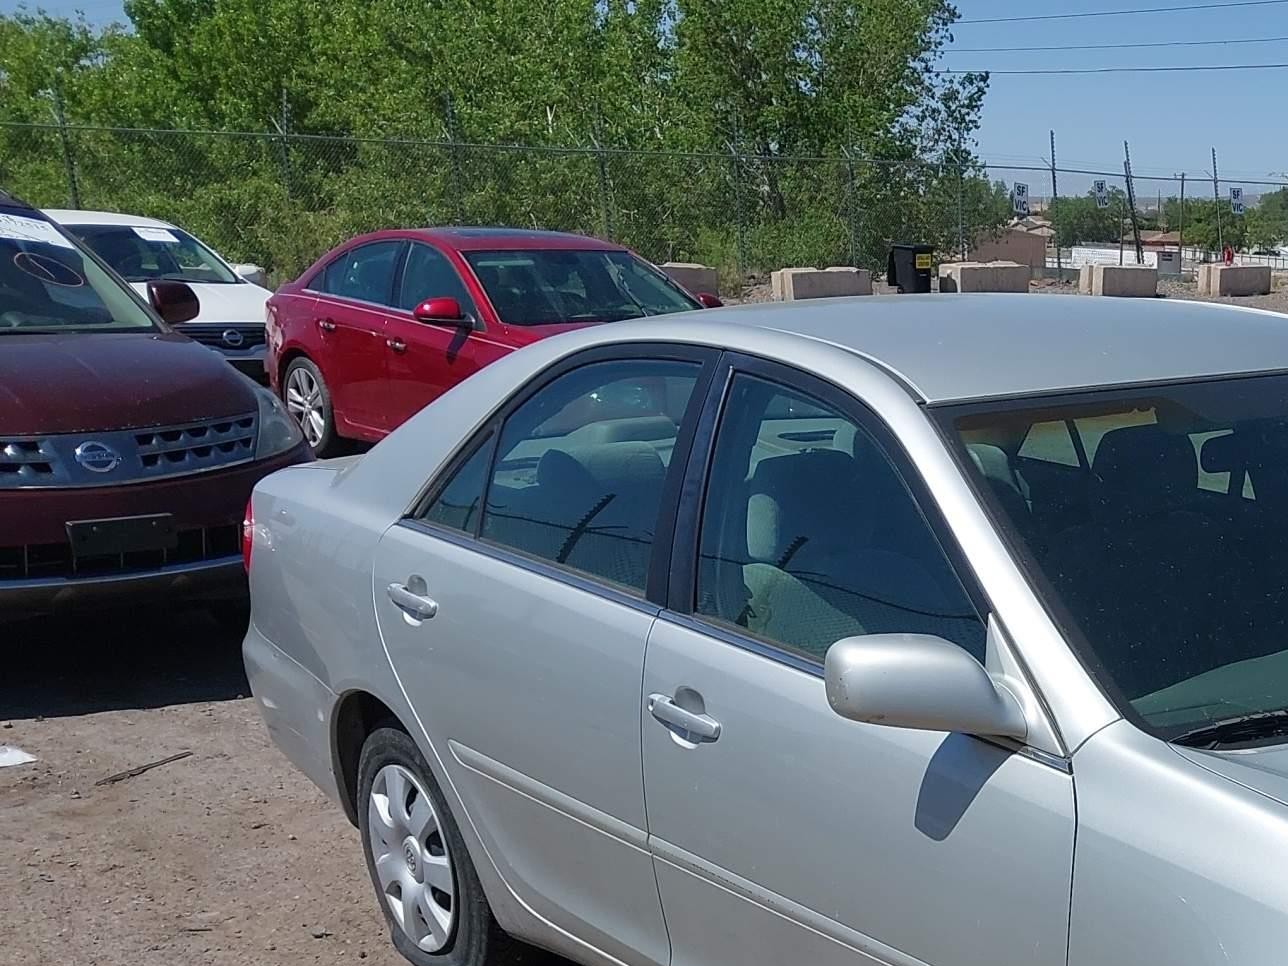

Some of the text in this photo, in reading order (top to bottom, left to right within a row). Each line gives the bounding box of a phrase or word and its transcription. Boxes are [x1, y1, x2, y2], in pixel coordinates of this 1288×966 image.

[1016, 185, 1026, 197] SF
[1232, 190, 1240, 200] SF
[1014, 199, 1027, 211] VIC
[1231, 202, 1243, 212] VIC
